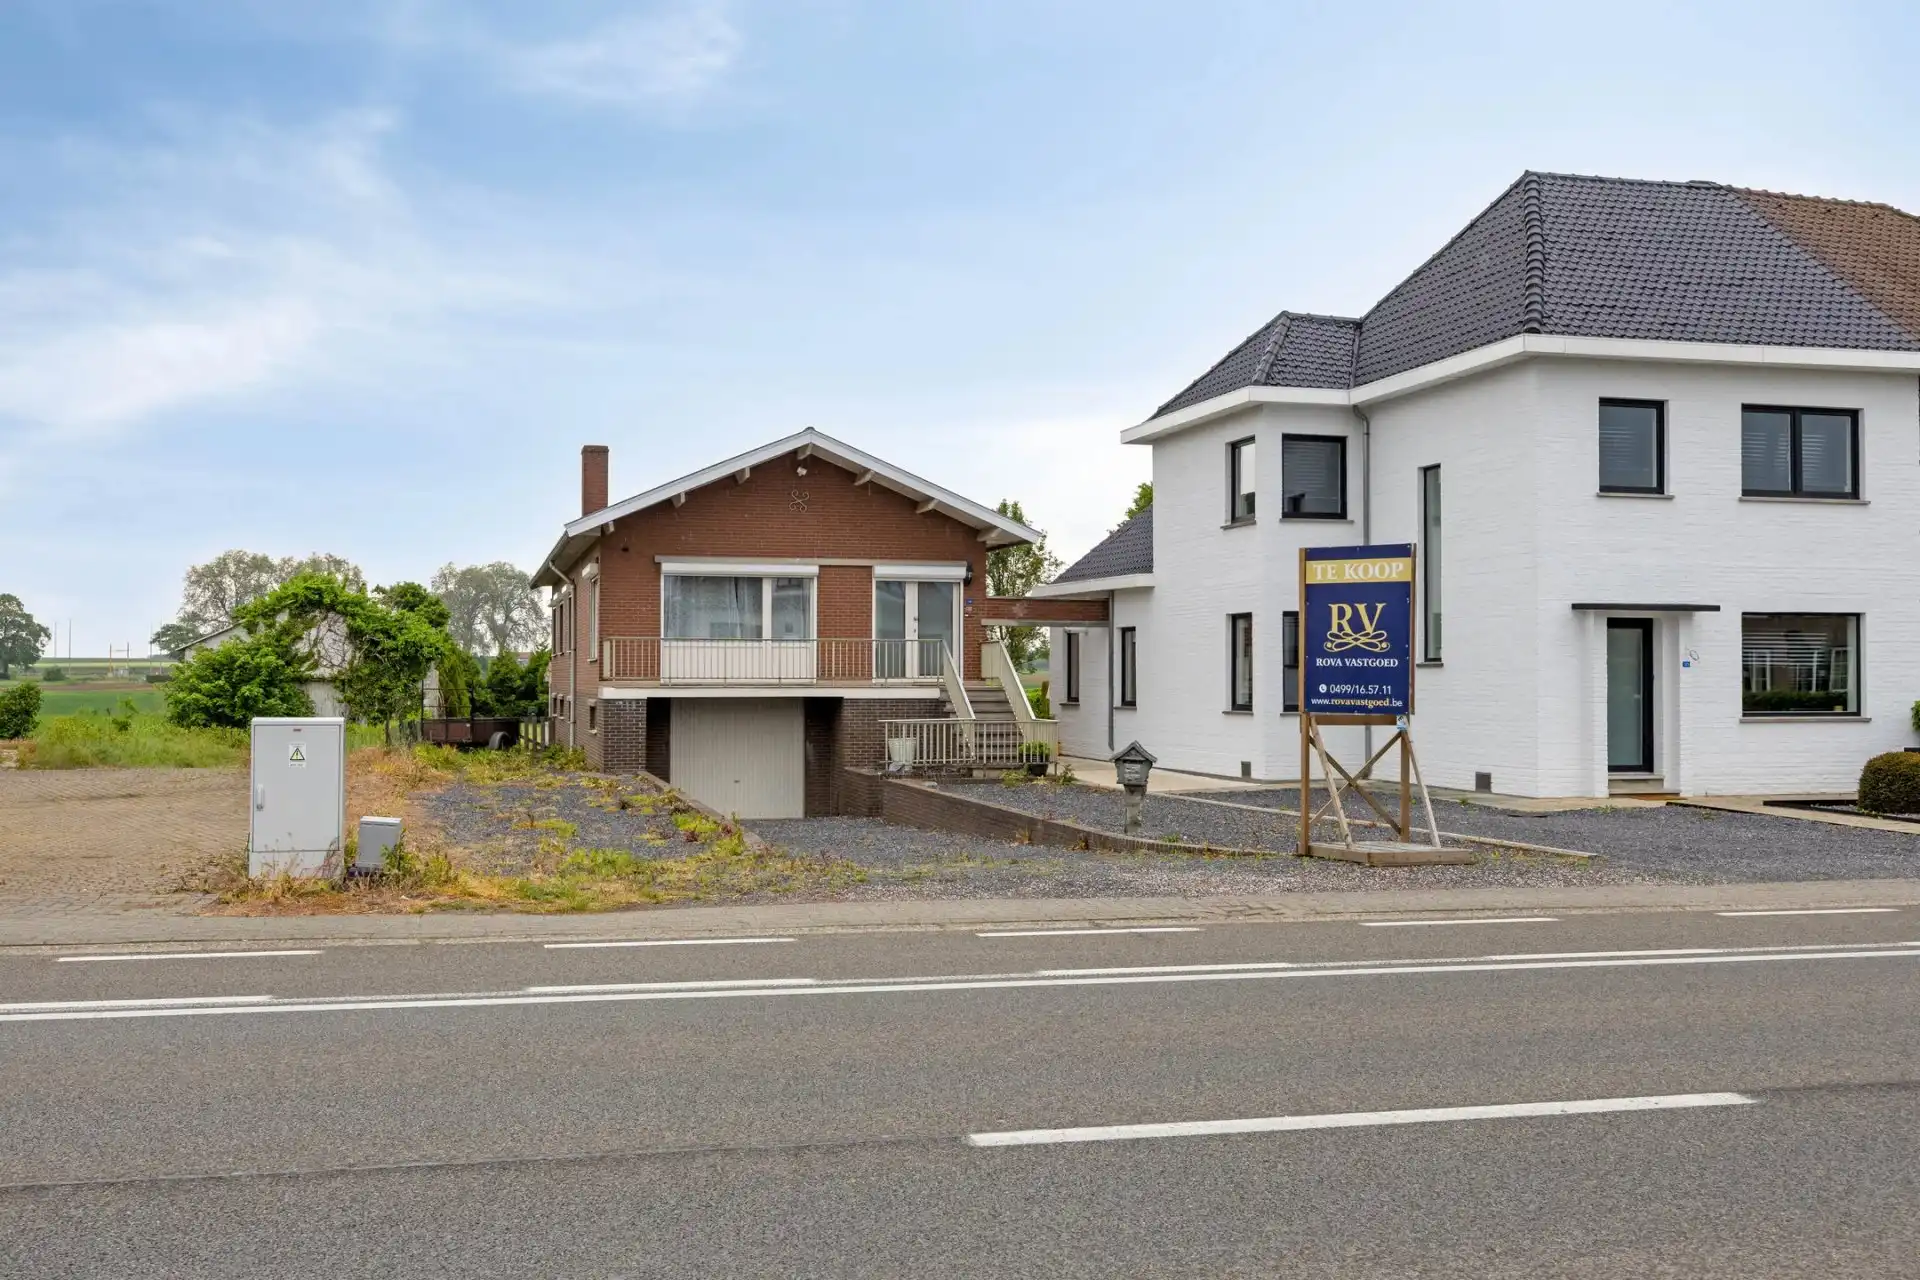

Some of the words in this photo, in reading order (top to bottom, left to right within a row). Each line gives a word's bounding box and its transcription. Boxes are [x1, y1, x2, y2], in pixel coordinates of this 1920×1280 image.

[1313, 564, 1337, 580] TE
[1344, 562, 1404, 579] KOOP
[1328, 603, 1386, 634] RV
[1316, 657, 1342, 667] ROVA
[1344, 658, 1398, 668] VASTGOED
[1329, 685, 1392, 695] 0499/16.57.11
[1311, 698, 1402, 708] www.rovavastgoed.be
